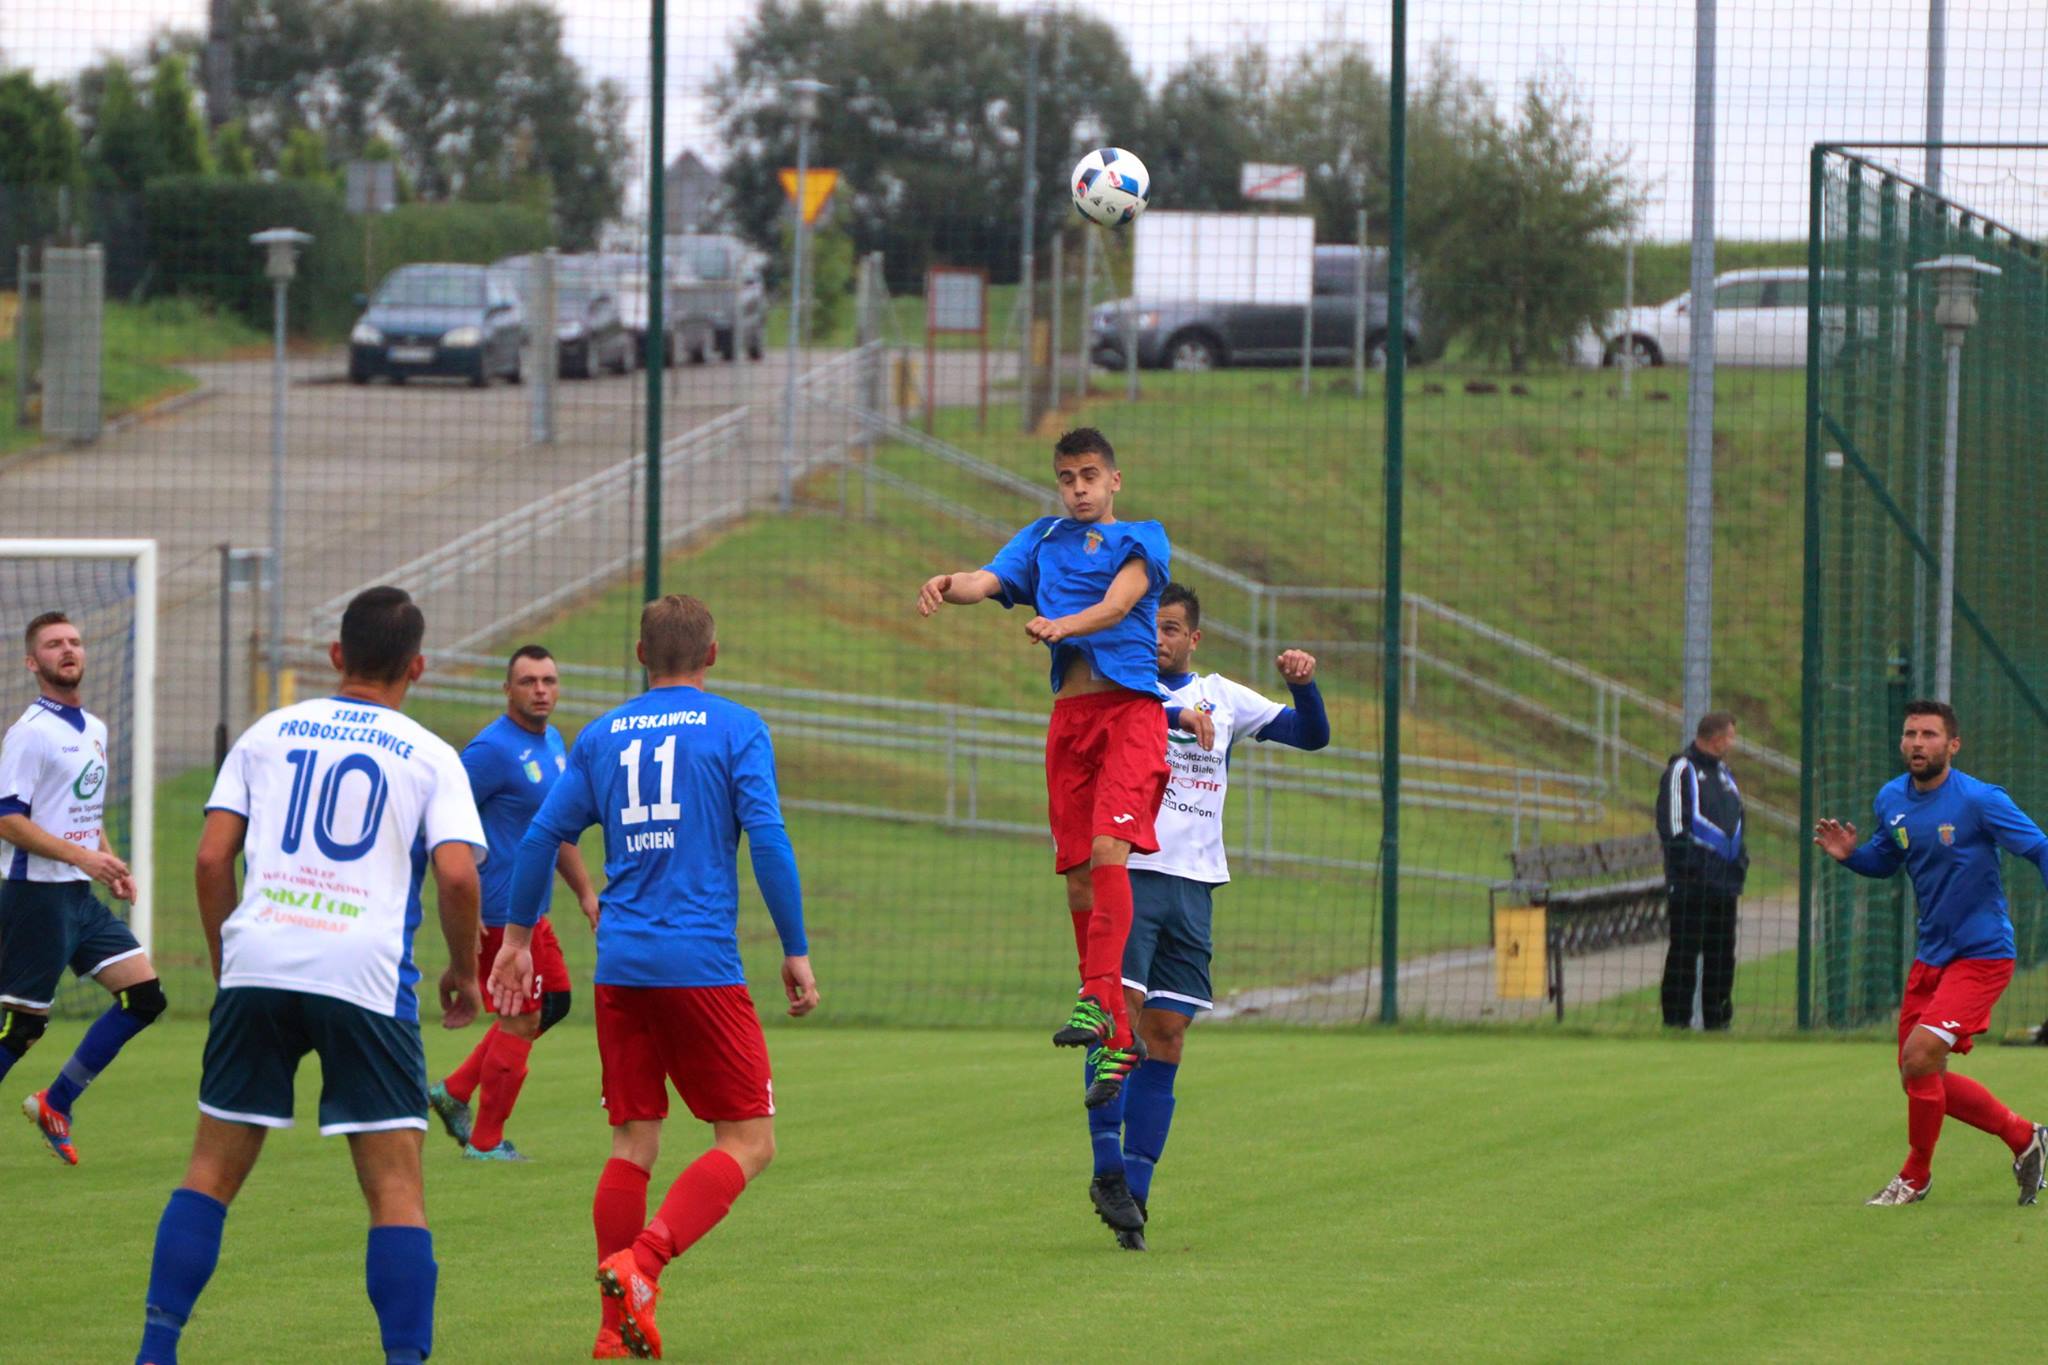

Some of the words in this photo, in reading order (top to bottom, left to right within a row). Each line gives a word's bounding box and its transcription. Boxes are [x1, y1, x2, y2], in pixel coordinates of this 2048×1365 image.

[332, 709, 378, 724] START
[610, 710, 708, 734] BŁYSKAWICA
[278, 719, 414, 760] PROBOSZCZEWICE
[620, 734, 681, 825] 11
[1171, 776, 1222, 792] romir
[281, 749, 388, 862] 10
[626, 827, 675, 853] LUCIEŃ
